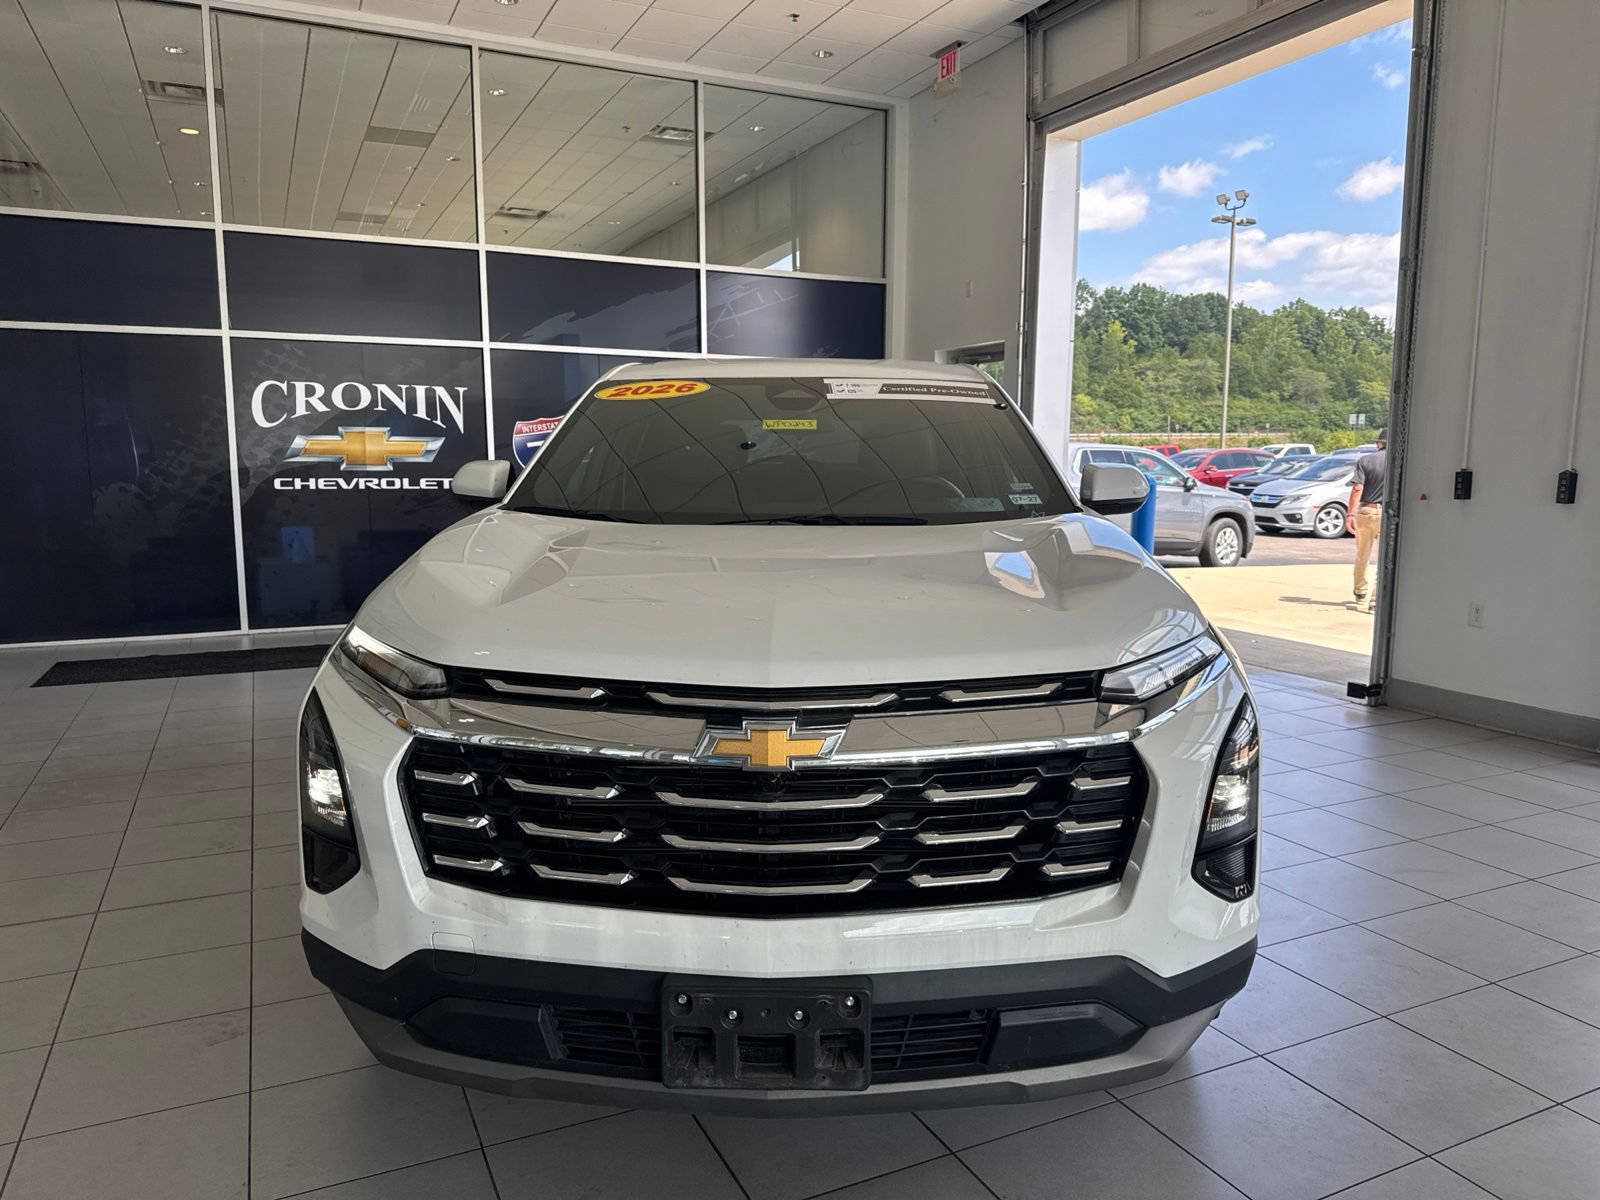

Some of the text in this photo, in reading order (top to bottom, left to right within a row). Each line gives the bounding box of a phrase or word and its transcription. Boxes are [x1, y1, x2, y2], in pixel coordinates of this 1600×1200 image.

[940, 50, 957, 79] EXIT
[607, 383, 698, 398] 2026
[930, 388, 986, 396] Pre-Owned
[251, 380, 467, 434] CRONIN
[521, 421, 559, 433] INTERSTAT
[273, 477, 453, 490] CHEVROLET
